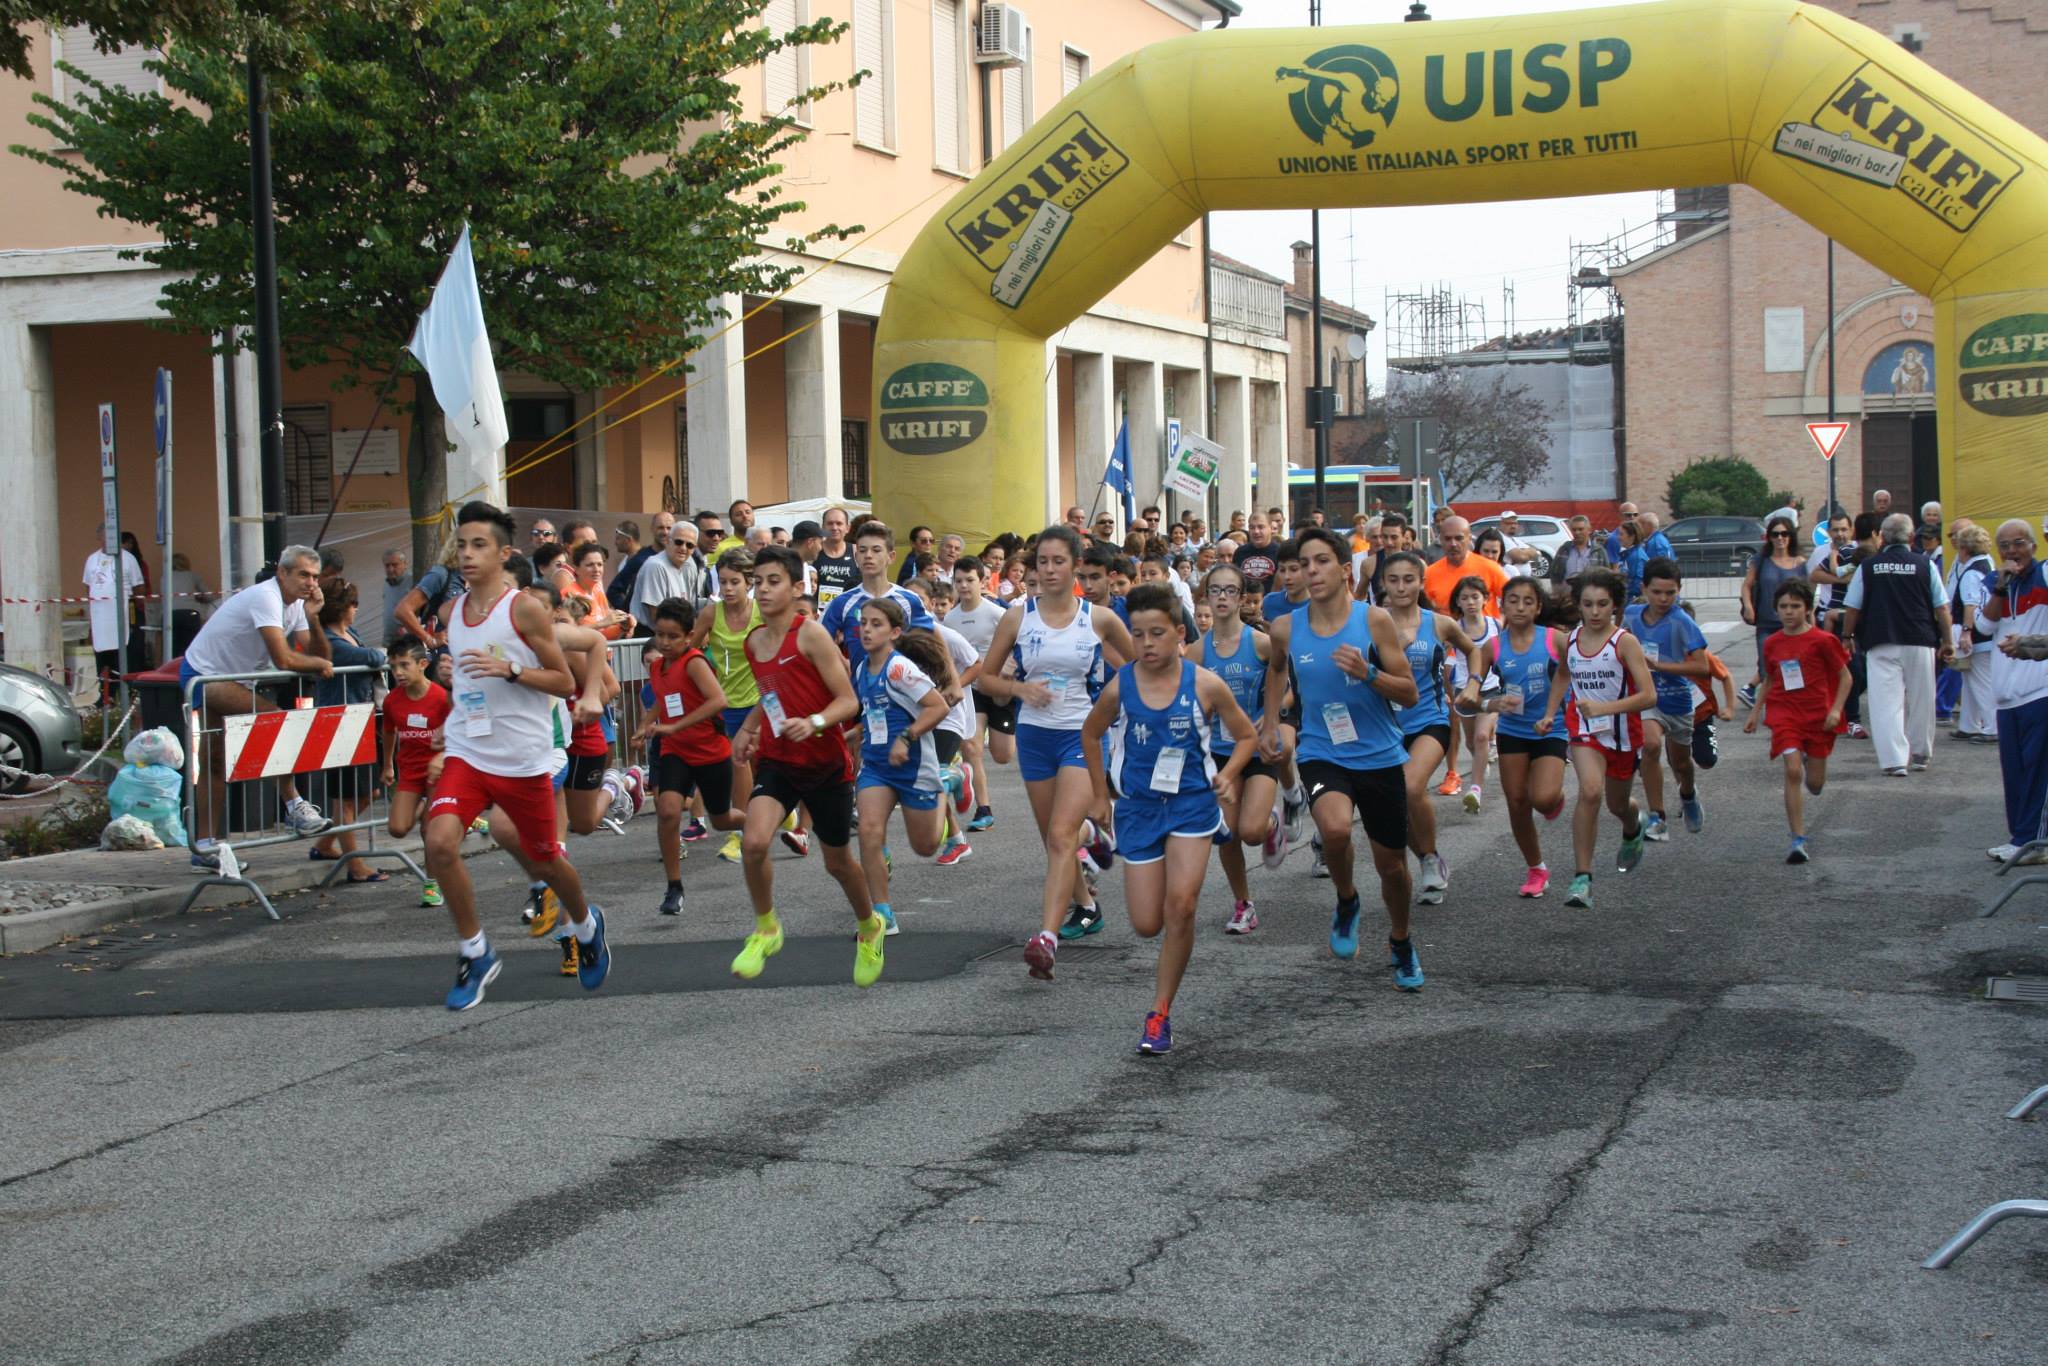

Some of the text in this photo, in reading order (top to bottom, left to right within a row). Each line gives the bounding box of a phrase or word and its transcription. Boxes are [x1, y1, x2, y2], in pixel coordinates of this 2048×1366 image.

[1424, 37, 1632, 122] UISP
[1278, 130, 1638, 175] UNIONE ITALIANA SPORT PER TUTTI
[1794, 136, 1813, 152] nei
[1817, 144, 1865, 168] migliori
[1831, 77, 2002, 210] KRIFI
[958, 127, 1108, 254] KRIFI
[1008, 272, 1023, 290] nei
[1019, 236, 1046, 273] migliori
[888, 421, 971, 440] KRIFI
[1171, 427, 1178, 456] P
[1873, 562, 1917, 571] CERCOLOR
[1598, 670, 1615, 678] Club
